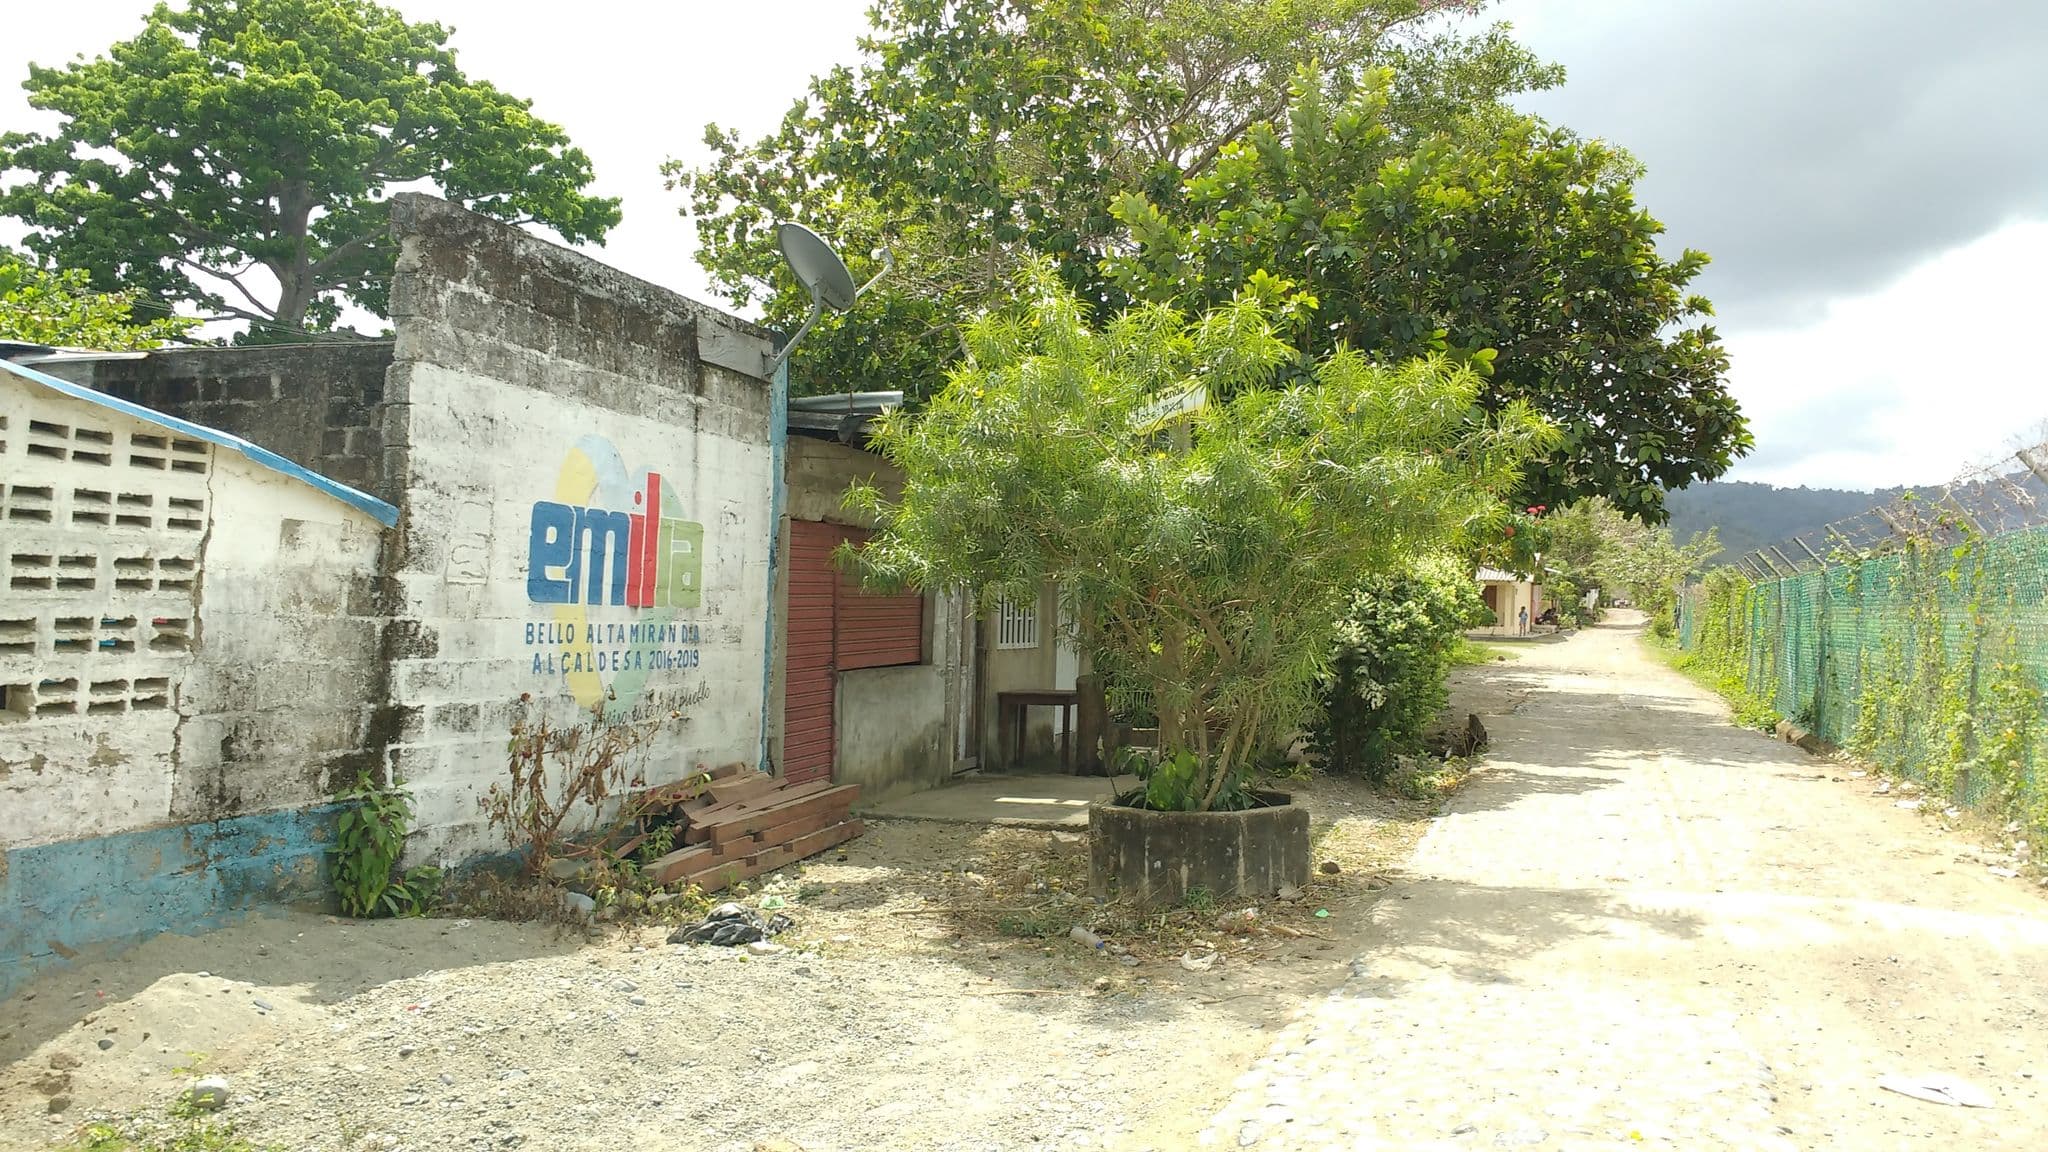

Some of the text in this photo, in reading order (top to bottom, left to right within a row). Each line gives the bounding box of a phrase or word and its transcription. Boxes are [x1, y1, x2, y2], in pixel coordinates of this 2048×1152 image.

[525, 622, 575, 645] BELLO
[532, 649, 699, 675] ALCALDESA 2016-2019
